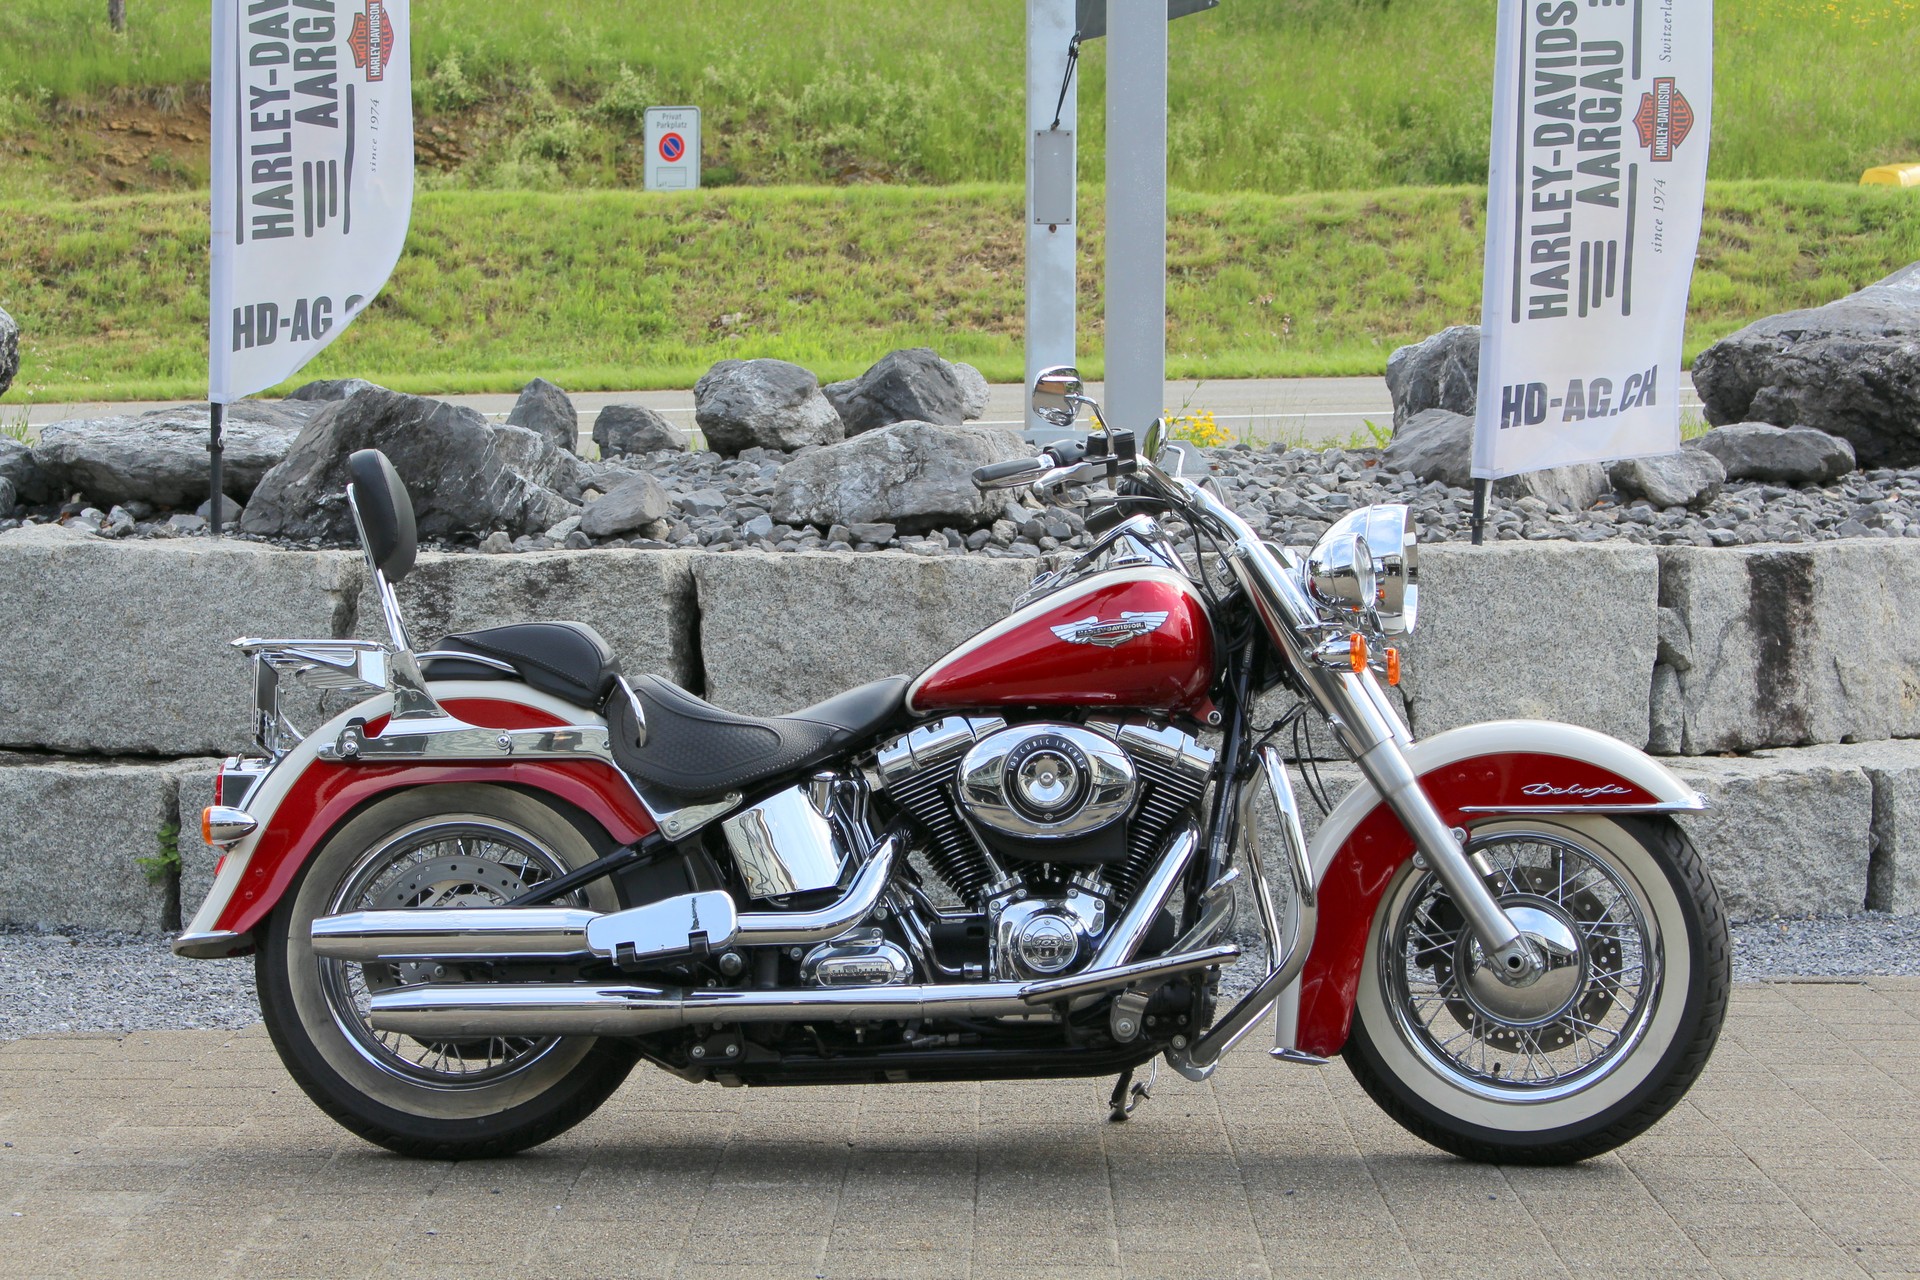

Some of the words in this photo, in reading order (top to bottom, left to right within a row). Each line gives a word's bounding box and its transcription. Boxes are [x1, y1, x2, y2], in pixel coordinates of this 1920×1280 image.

[352, 21, 367, 59] MOTOR
[369, 3, 380, 76] HARLEY-DAVIDSON
[370, 98, 380, 131] 1974
[656, 121, 687, 130] Parkplatz
[1576, 40, 1625, 208] AARGAU
[1639, 100, 1653, 139] MOTOR
[1655, 82, 1670, 157] HARLEY-DAVIDSON
[1672, 100, 1690, 139] CYCLES
[369, 138, 378, 172] since
[1528, 1, 1578, 319] HARLEY-DAVIDS
[1653, 178, 1666, 212] 1974
[1651, 218, 1663, 254] since
[1500, 364, 1658, 430] HD-AG.CH
[1008, 755, 1019, 771] 103
[1020, 738, 1050, 754] CUBIC
[1055, 740, 1086, 769] INCHES
[1520, 782, 1632, 798] Deluxe
